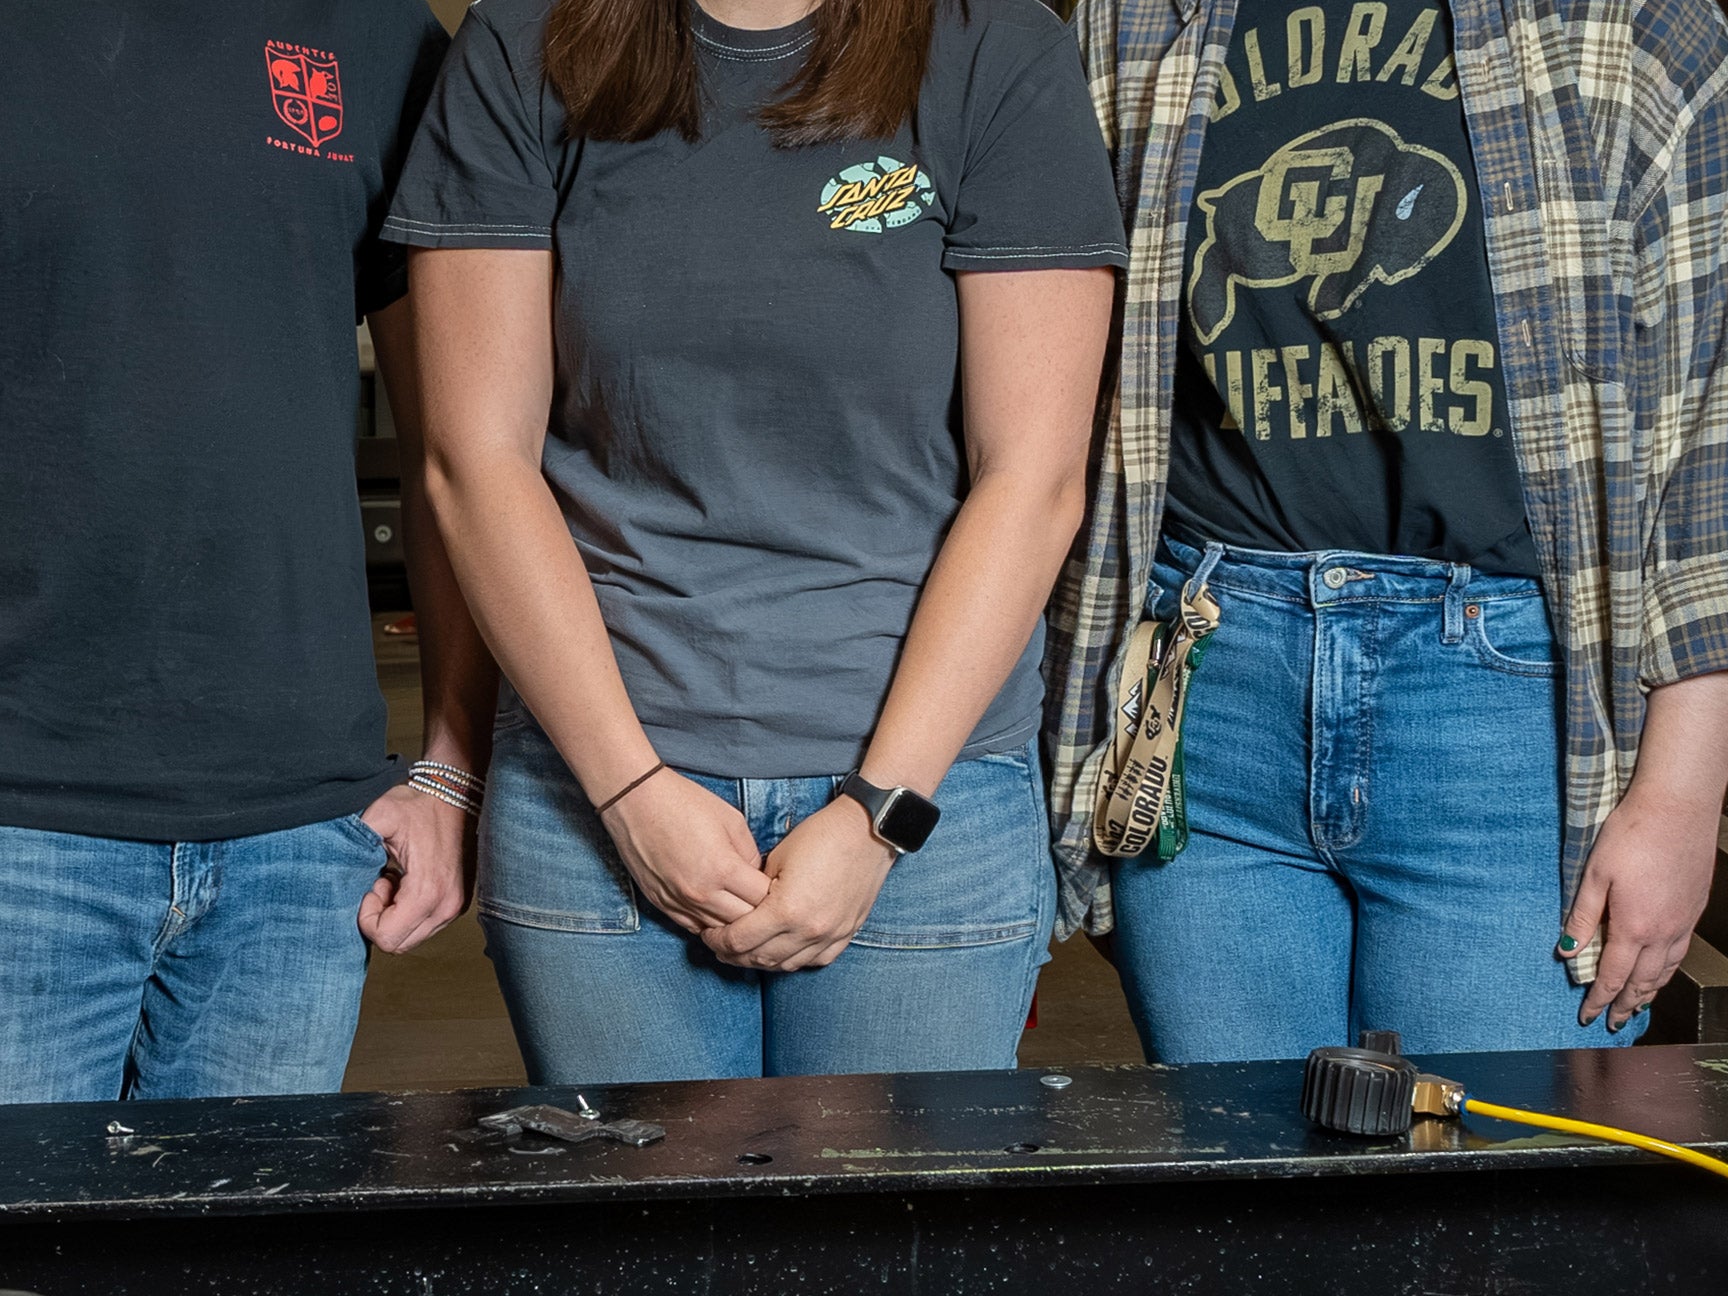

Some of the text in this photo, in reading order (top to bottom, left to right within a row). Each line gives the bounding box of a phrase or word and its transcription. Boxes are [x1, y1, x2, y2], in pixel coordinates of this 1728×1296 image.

[817, 164, 918, 213] SANTA
[830, 185, 916, 229] CRUZ
[1255, 146, 1384, 275] CU
[1119, 755, 1168, 854] COLORADO
